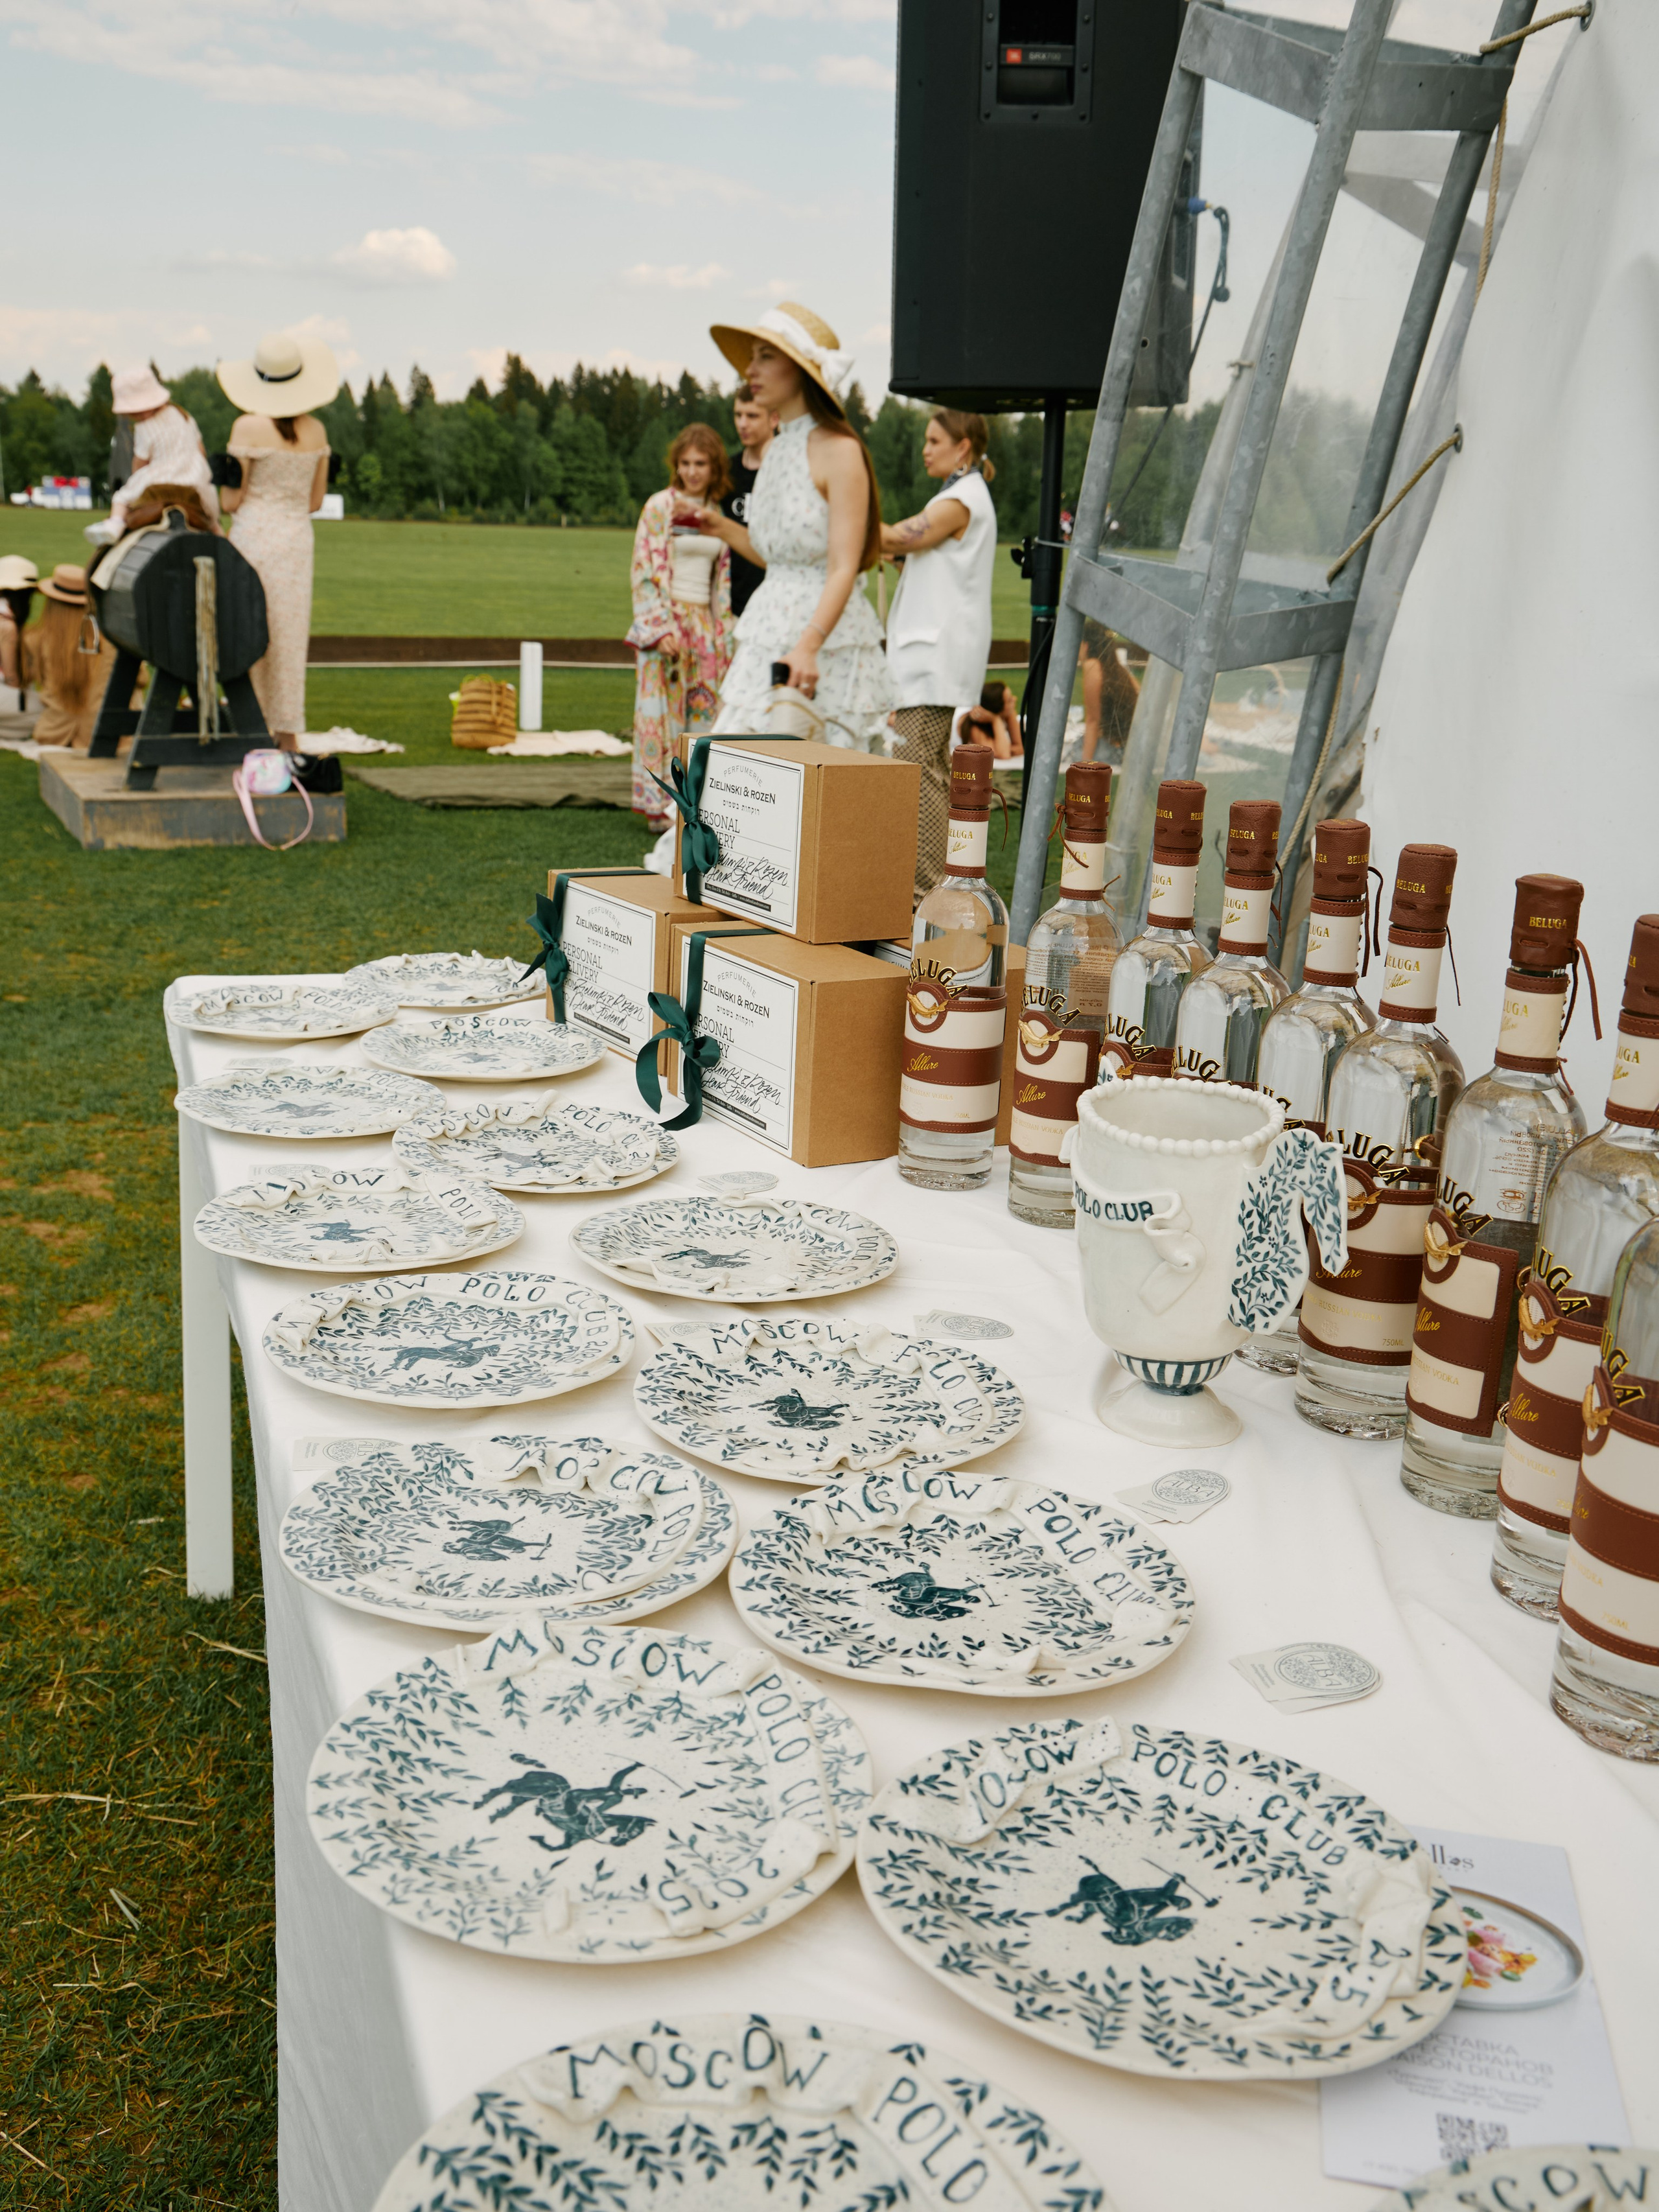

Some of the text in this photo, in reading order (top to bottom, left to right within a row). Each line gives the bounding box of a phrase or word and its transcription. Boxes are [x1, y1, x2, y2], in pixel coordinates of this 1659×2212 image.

[723, 765, 763, 787] PERFUMERIE
[953, 771, 976, 780] BELUGA
[710, 778, 776, 804] ZIELINSKI & ROZEN
[1069, 793, 1091, 803] BELUGA
[699, 809, 740, 833] ERSONAL
[1230, 828, 1255, 840] BELUGA
[1397, 879, 1426, 893] BELUGA
[587, 906, 621, 929] PERFUMERIE
[1529, 916, 1567, 929] BELUGA
[576, 915, 632, 946] ZIELINSKI & ROZEN
[568, 959, 599, 983] ELIVERY
[717, 971, 756, 998] PERFUMERIE
[703, 980, 770, 1018] ZIELINSKI & ROZEN
[907, 1053, 939, 1072] Allure
[1016, 1083, 1047, 1106] Allure
[560, 1104, 613, 1134] POLO
[1074, 1180, 1154, 1223] POLO CLUB
[459, 1277, 547, 1303] POLO
[1318, 1300, 1382, 1322] RUSSIAN VODKA
[1433, 1368, 1459, 1385] VODKA
[1527, 1458, 1557, 1478] VODKA
[1163, 1478, 1216, 1498] ALBA
[1025, 1498, 1098, 1565] POLO
[1303, 1654, 1343, 1688] ALBA
[745, 1673, 811, 1764] POLO
[1133, 1740, 1229, 1797] POLO
[1260, 1792, 1351, 1868] CLUB
[1424, 2033, 1519, 2056] ОСТАВКА
[1468, 2066, 1553, 2089] DELLOS
[567, 2024, 991, 2207] MOSCOW POLO
